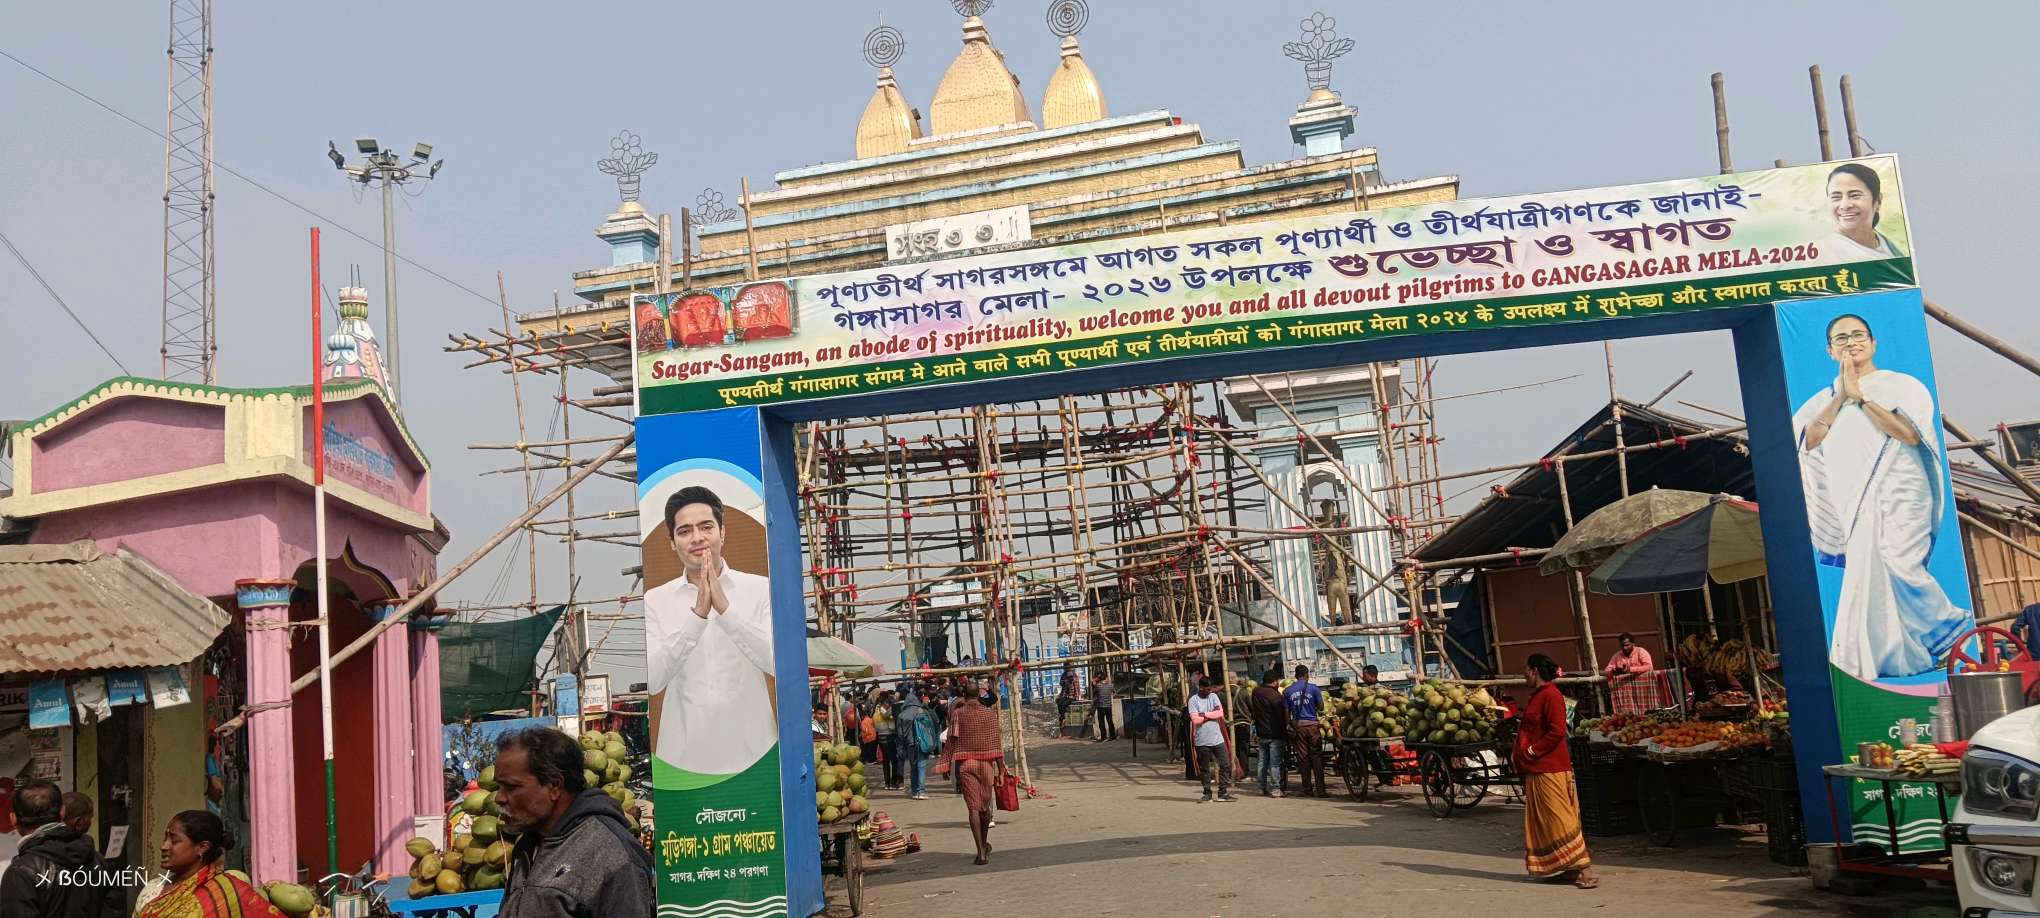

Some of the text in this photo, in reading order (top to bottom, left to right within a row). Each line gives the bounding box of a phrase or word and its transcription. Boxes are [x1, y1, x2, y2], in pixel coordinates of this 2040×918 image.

[834, 299, 963, 332] গঙ্গাসাগর
[1082, 274, 1172, 303] ২০২৬
[1179, 259, 1313, 290] উপলক্ষে
[1327, 235, 1517, 278] শুভেচ্ছা
[1535, 233, 1574, 257] ও
[1588, 217, 1737, 253] স্বাগত
[933, 256, 1088, 292] সাগরসঙ্গমে
[1095, 245, 1180, 271] আগত
[1185, 236, 1264, 260] সকল
[1387, 220, 1412, 239] ও
[1421, 199, 1642, 236] তীর্থযাত্রীগণকে
[651, 243, 1819, 381] Sagar-Sangam, an abode of spirituality, welcome you and all devout pilgrims to GANGASAGAR MELA-2026
[790, 370, 860, 394] गंगासागर
[865, 366, 905, 385] संगम
[933, 358, 966, 378] आने
[973, 353, 1008, 373] वाले
[1016, 350, 1051, 368] सभी
[1124, 335, 1152, 357] एवं
[1255, 322, 1281, 342] को
[1288, 319, 1364, 341] गंगासागर
[1368, 313, 1408, 332] मेला
[1417, 310, 1468, 328] २०२४
[1473, 303, 1494, 322] के
[1501, 300, 1567, 321] उपलक्ष्य
[1572, 295, 1591, 314] में
[1596, 291, 1663, 316] शुभेच्छा
[1671, 285, 1708, 305] और
[1712, 281, 1773, 300] स्वागत
[1778, 275, 1829, 294] करता
[696, 807, 746, 824] সৌজন্যে
[712, 833, 731, 856] গ্রাম
[733, 831, 776, 854] পঞ্চায়েত
[669, 871, 695, 883] সাগর,
[697, 867, 721, 881] দক্ষিণ
[723, 869, 737, 879] ২৪
